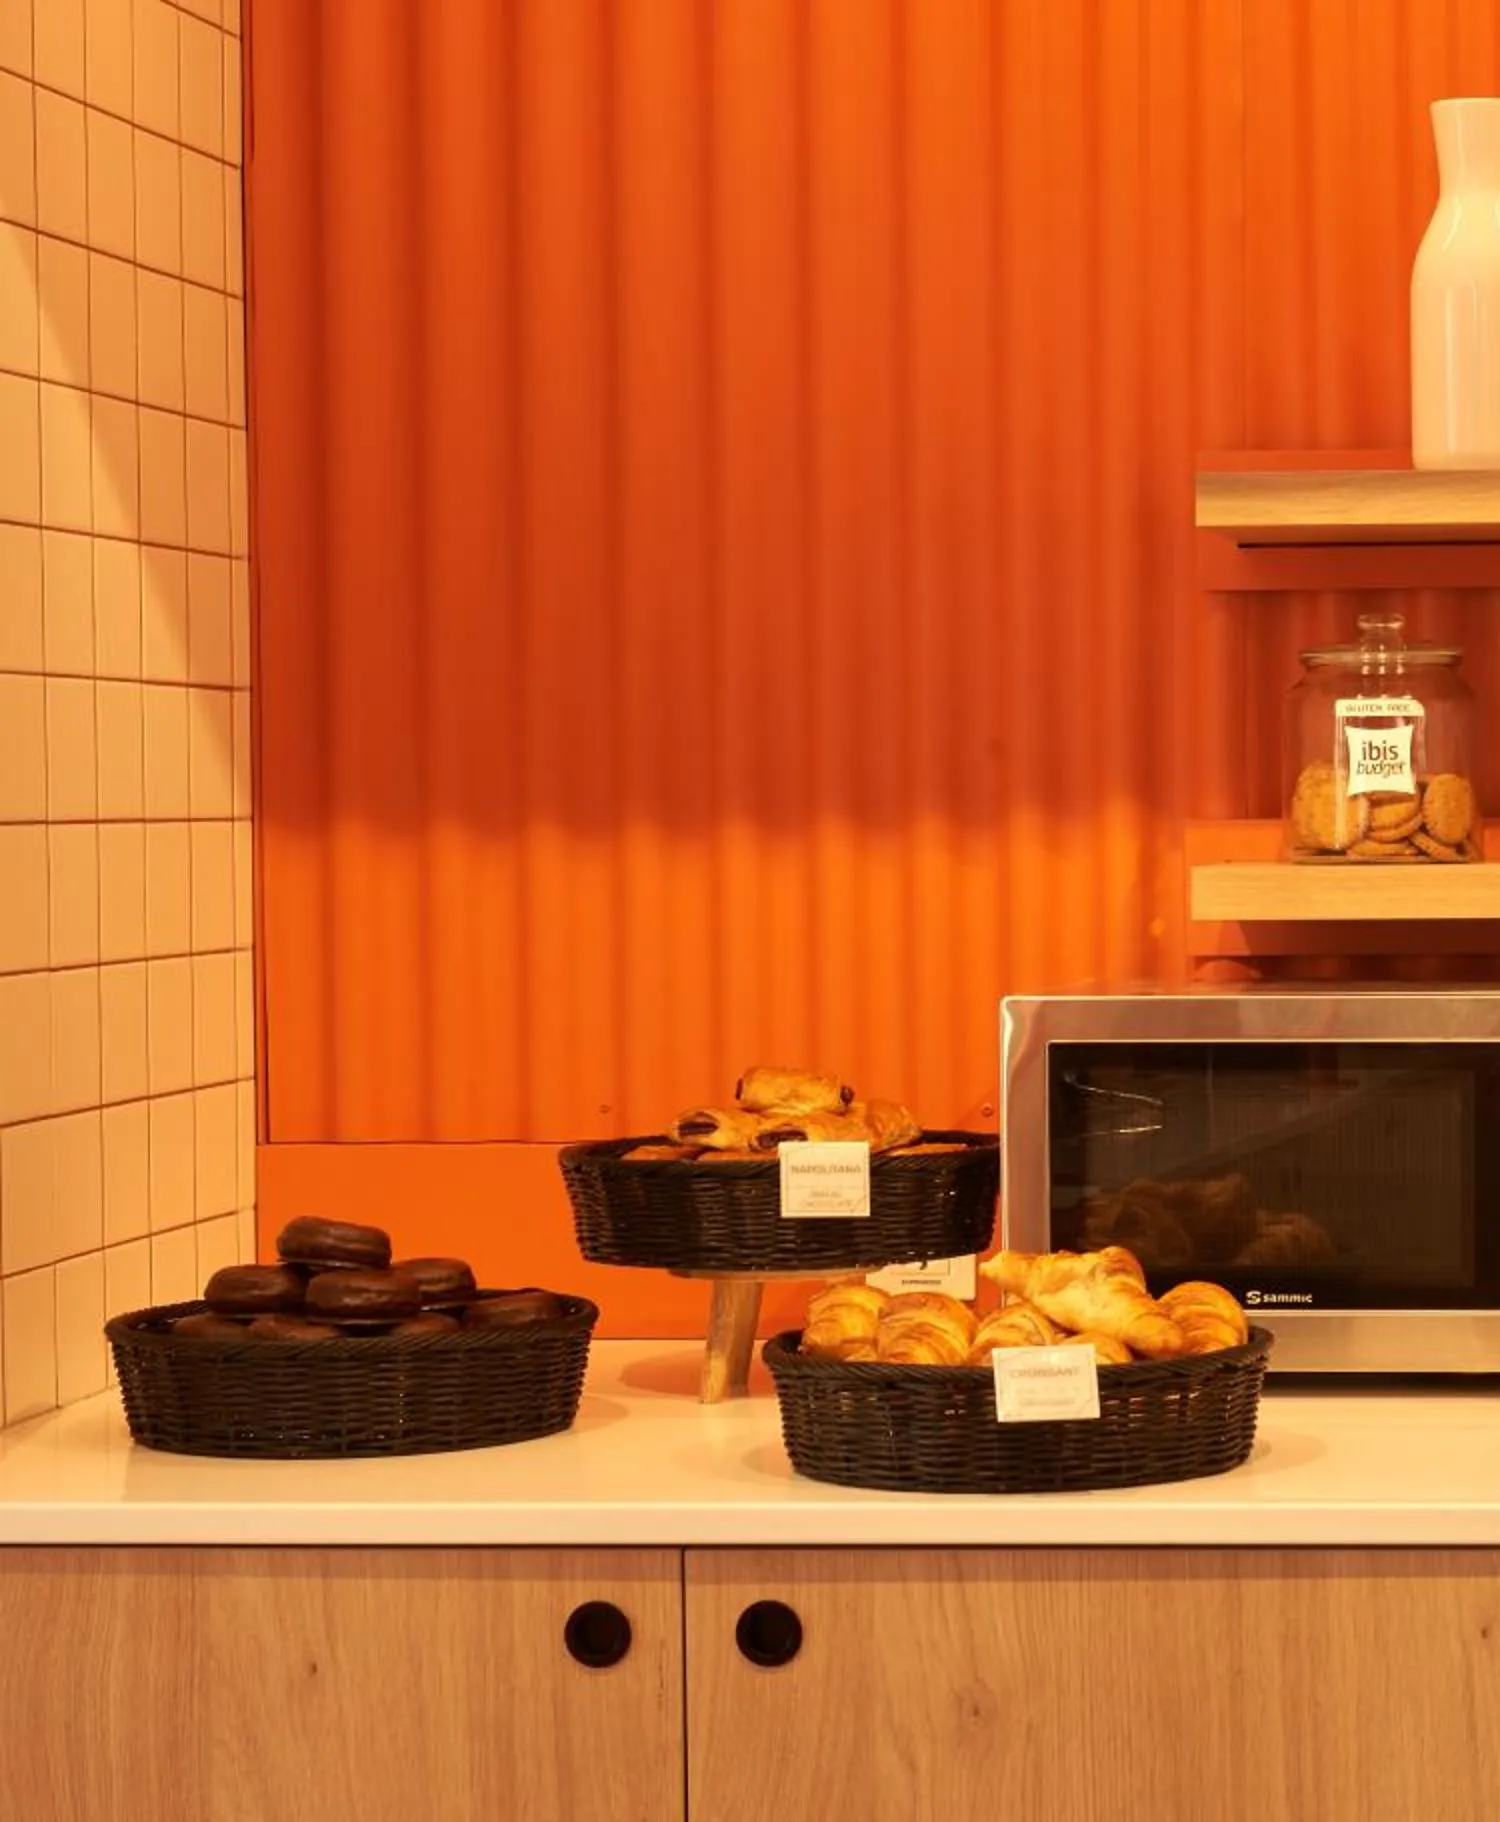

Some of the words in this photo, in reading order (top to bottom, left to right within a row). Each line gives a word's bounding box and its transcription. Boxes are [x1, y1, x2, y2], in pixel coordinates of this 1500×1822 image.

[1345, 703, 1383, 713] GLUTEN
[1361, 740, 1399, 761] ibis
[1355, 760, 1406, 778] budget
